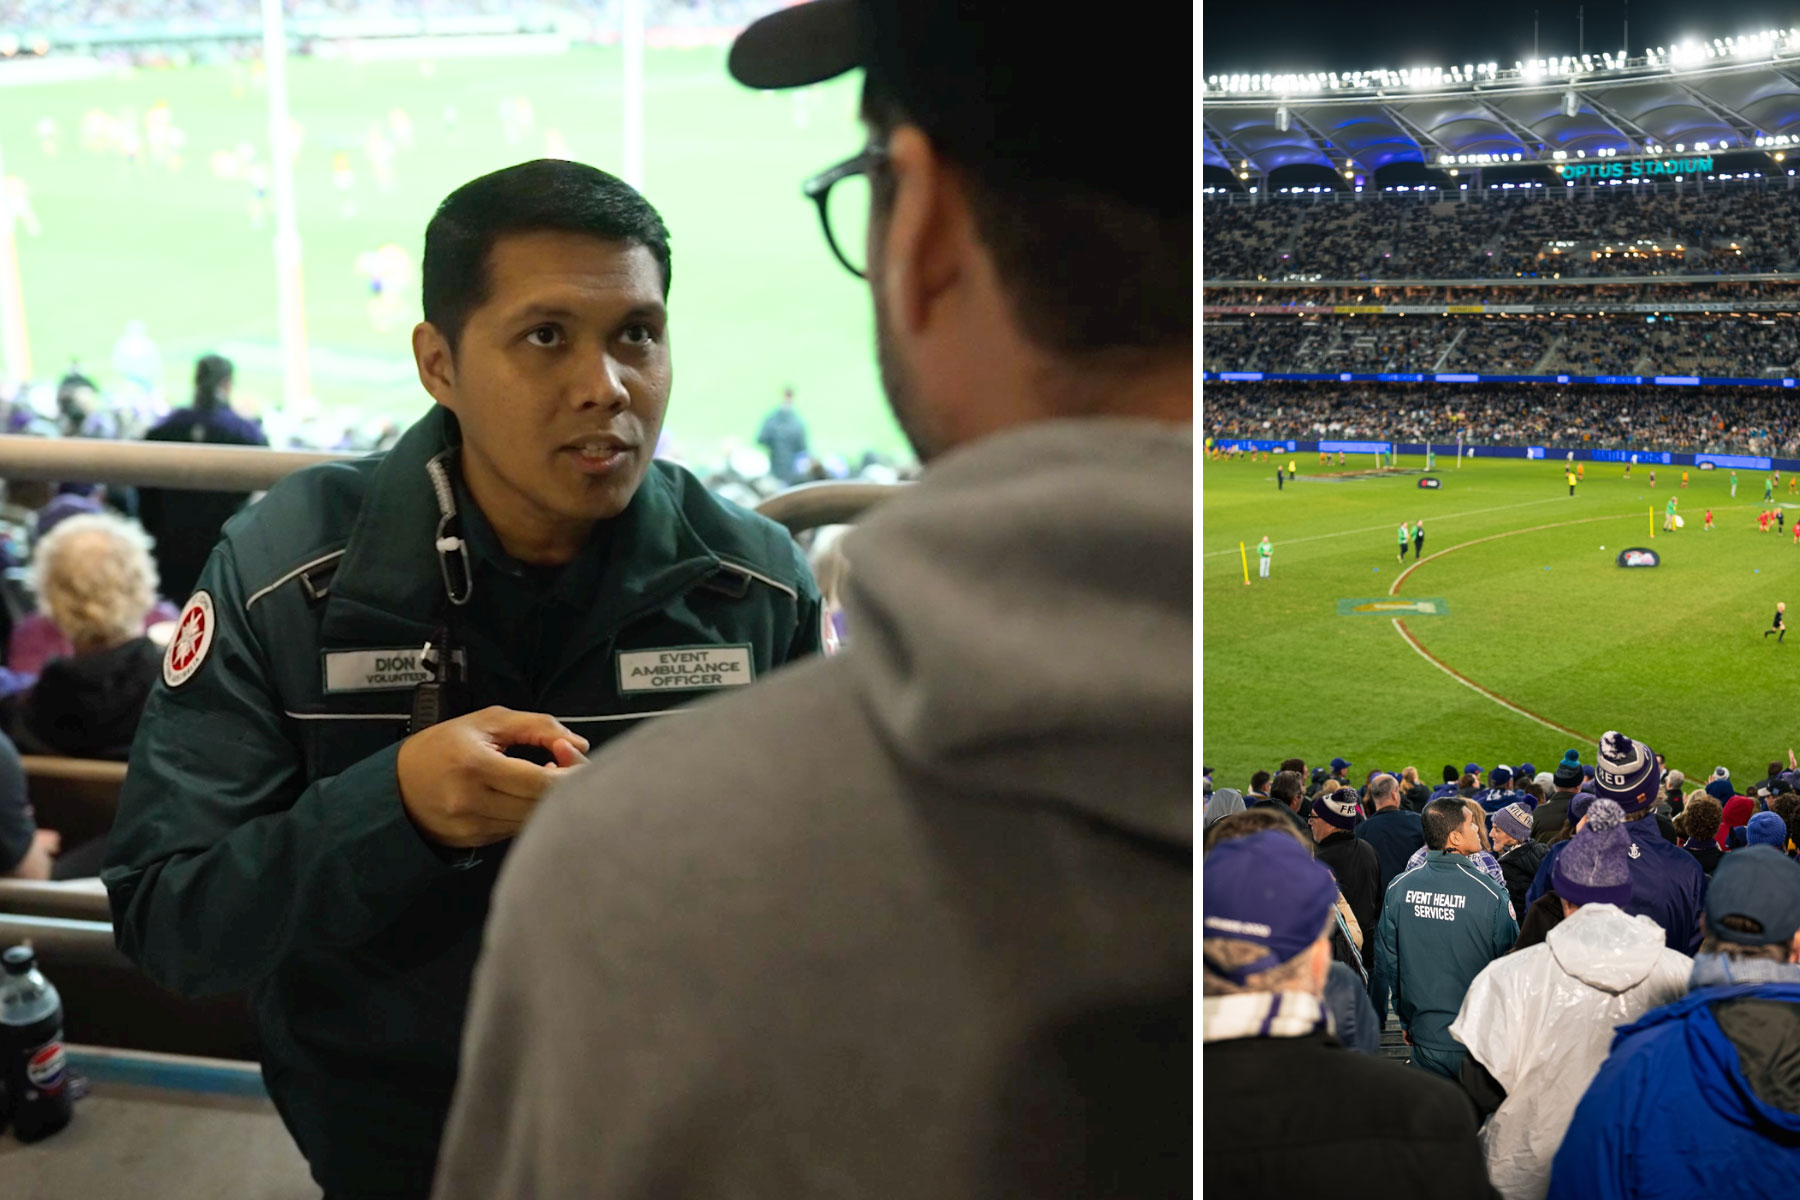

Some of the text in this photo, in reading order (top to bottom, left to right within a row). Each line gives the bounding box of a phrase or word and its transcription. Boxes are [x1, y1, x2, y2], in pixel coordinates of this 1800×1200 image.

[1561, 157, 1714, 180] OPTUS STADIUM
[374, 656, 416, 672] DION
[659, 651, 709, 664] EVENT
[630, 661, 741, 677] AMBULANCE
[365, 671, 428, 684] VOLUNTEER
[650, 673, 722, 687] OFFICER
[1405, 890, 1466, 909] EVENT HEALTH
[1414, 905, 1456, 922] SERVICES
